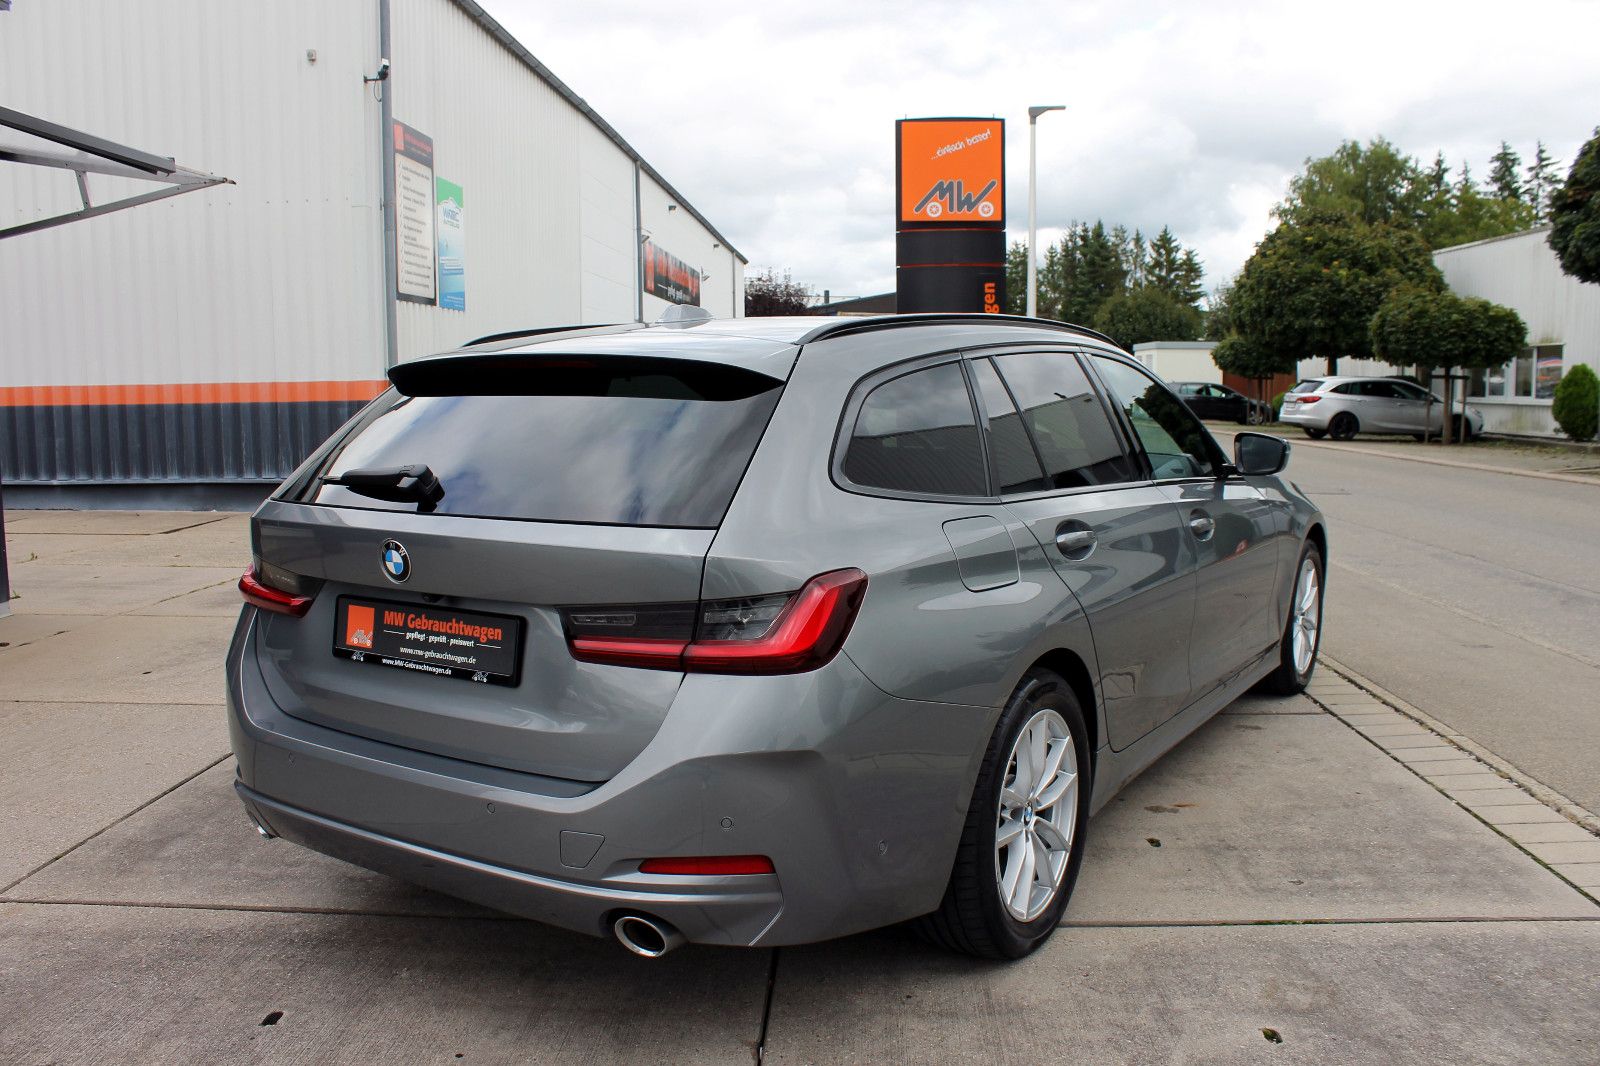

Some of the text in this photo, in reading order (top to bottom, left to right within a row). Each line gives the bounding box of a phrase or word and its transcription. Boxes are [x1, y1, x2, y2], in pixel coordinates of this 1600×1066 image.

[913, 179, 998, 214] MW
[384, 610, 502, 643] MW Gebrauchtwagen
[405, 631, 475, 647] gepflegt geprüft preiswert
[399, 647, 476, 664] www.mw-gebrauchtwagen.de
